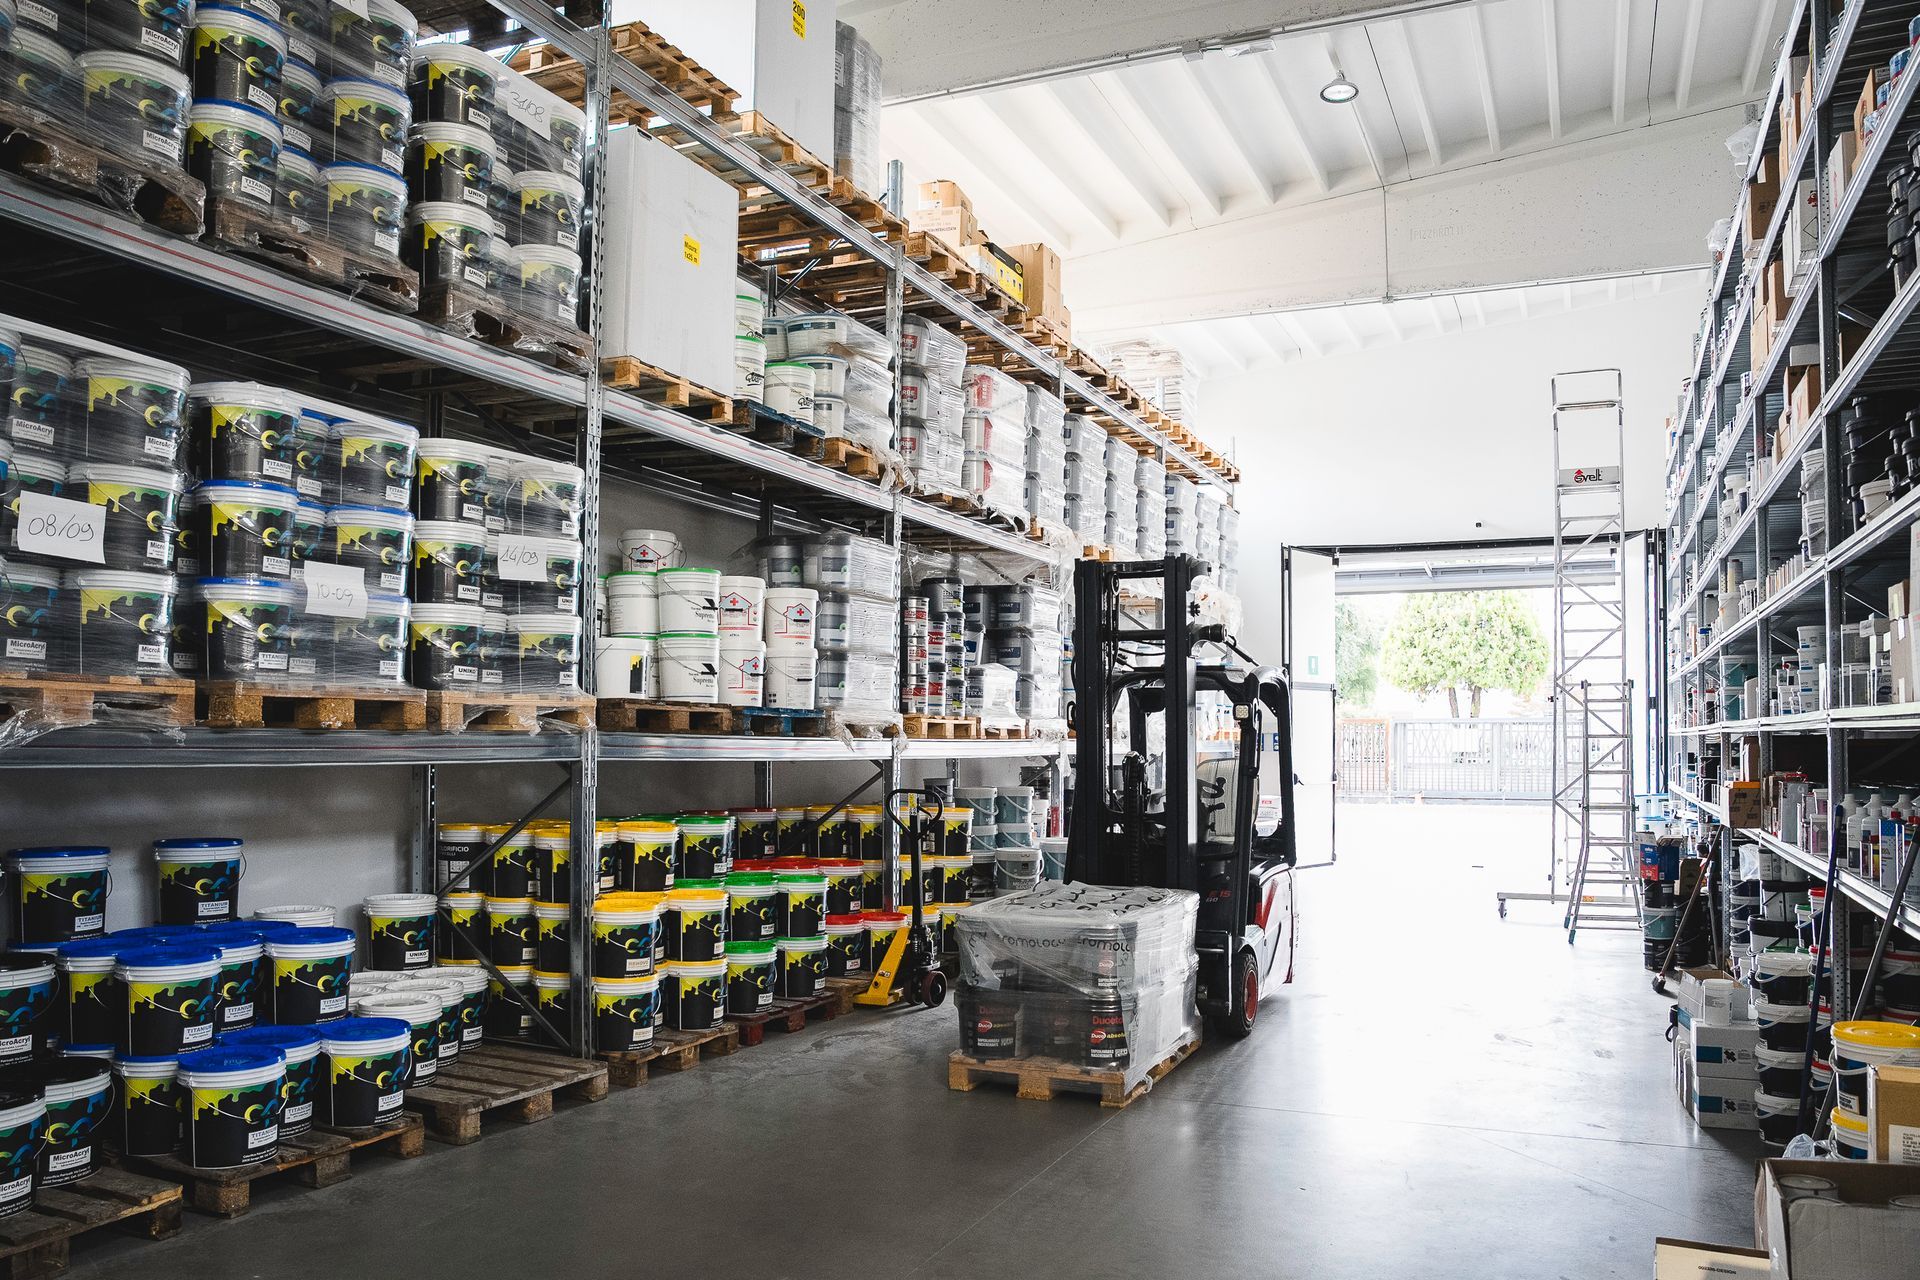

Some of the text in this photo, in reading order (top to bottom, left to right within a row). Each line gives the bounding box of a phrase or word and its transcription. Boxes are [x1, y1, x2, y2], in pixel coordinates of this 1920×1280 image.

[145, 29, 179, 50] MicroAcryl
[472, 110, 490, 123] UNIKO
[467, 188, 486, 201] UNIKO
[468, 268, 486, 282] UNIKO
[16, 419, 53, 434] MicroAcryl
[28, 513, 95, 542] 08/09
[500, 546, 539, 566] 14/09
[316, 582, 354, 607] 10-09
[10, 639, 46, 650] MicroAcryl
[0, 1036, 31, 1047] icroAcryl
[53, 1147, 90, 1162] MicroAcryl
[0, 1176, 31, 1193] icroAcryl
